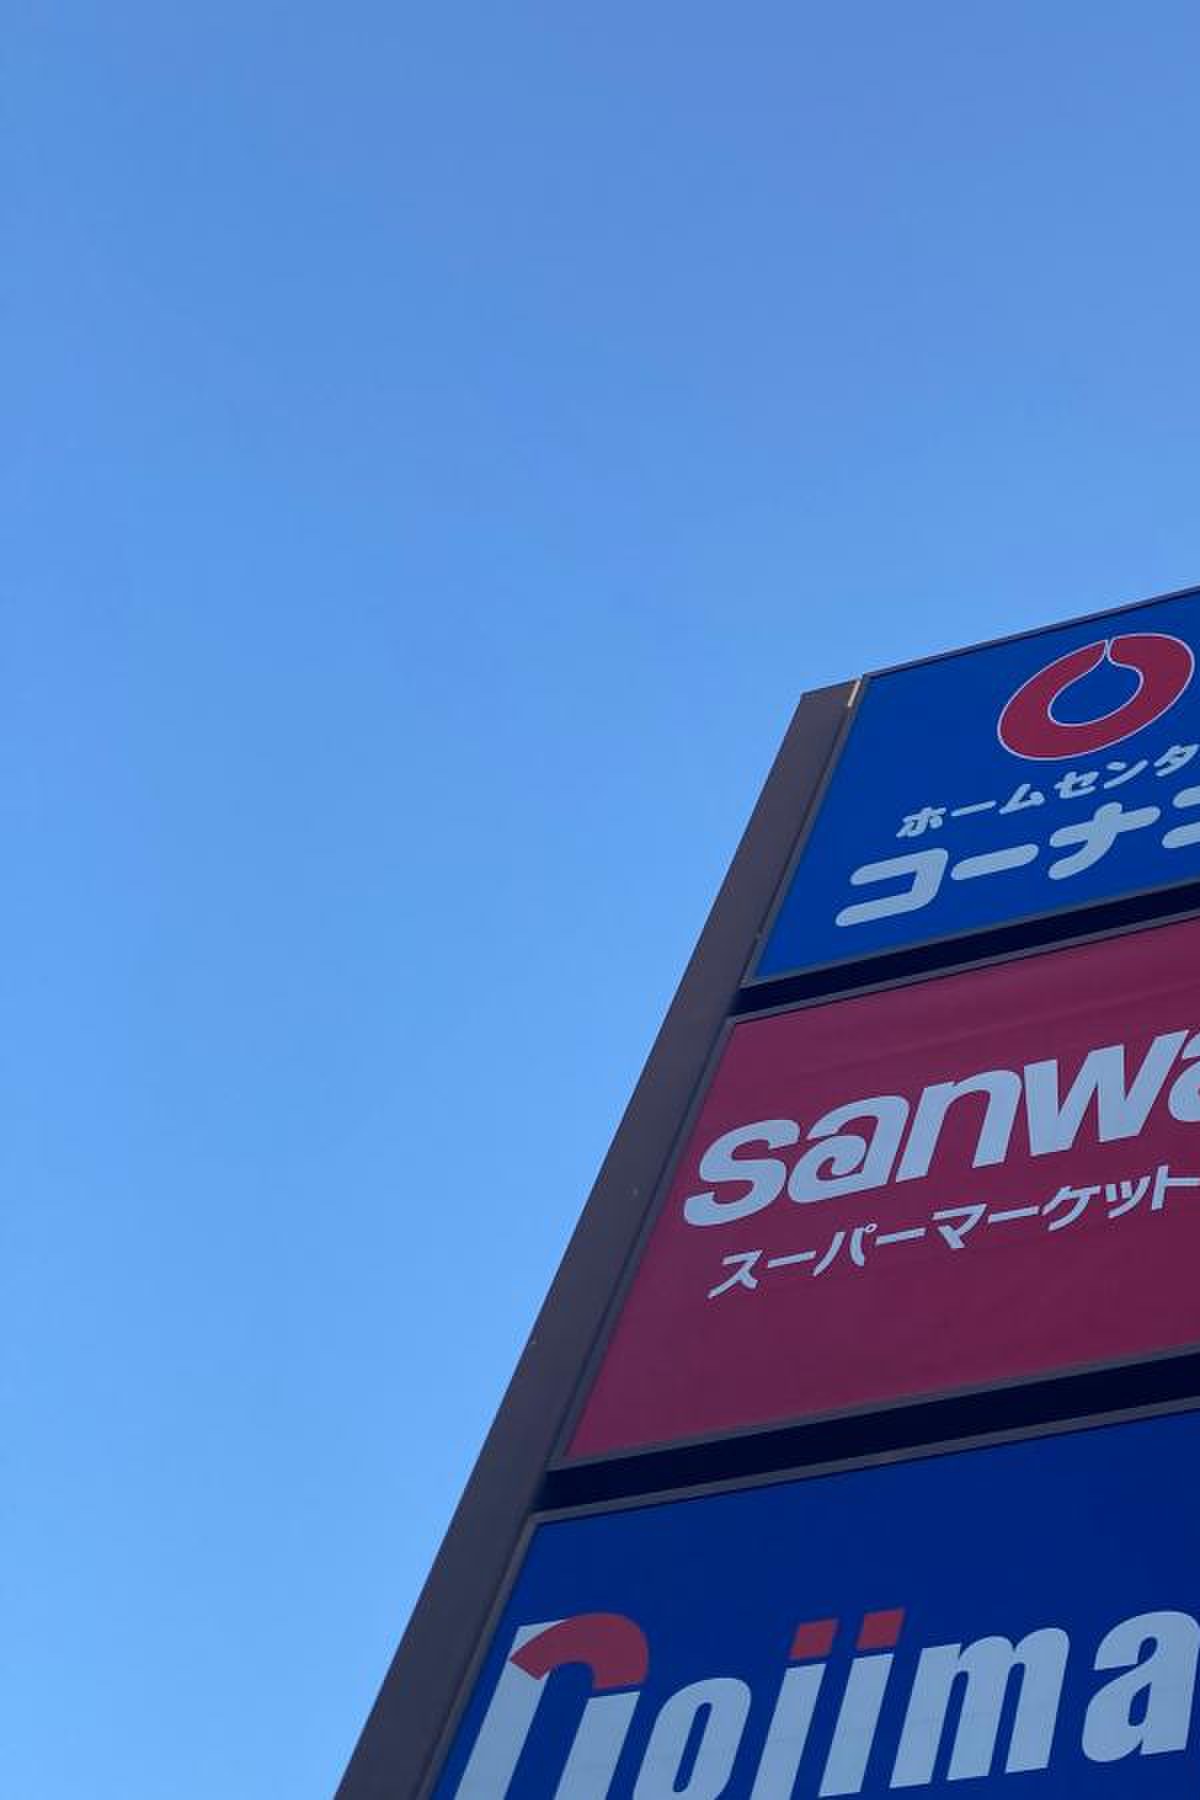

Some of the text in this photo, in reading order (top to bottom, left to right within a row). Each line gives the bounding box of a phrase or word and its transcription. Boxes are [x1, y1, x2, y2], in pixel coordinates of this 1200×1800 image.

[708, 1165, 1200, 1299] スーパーマーケット
